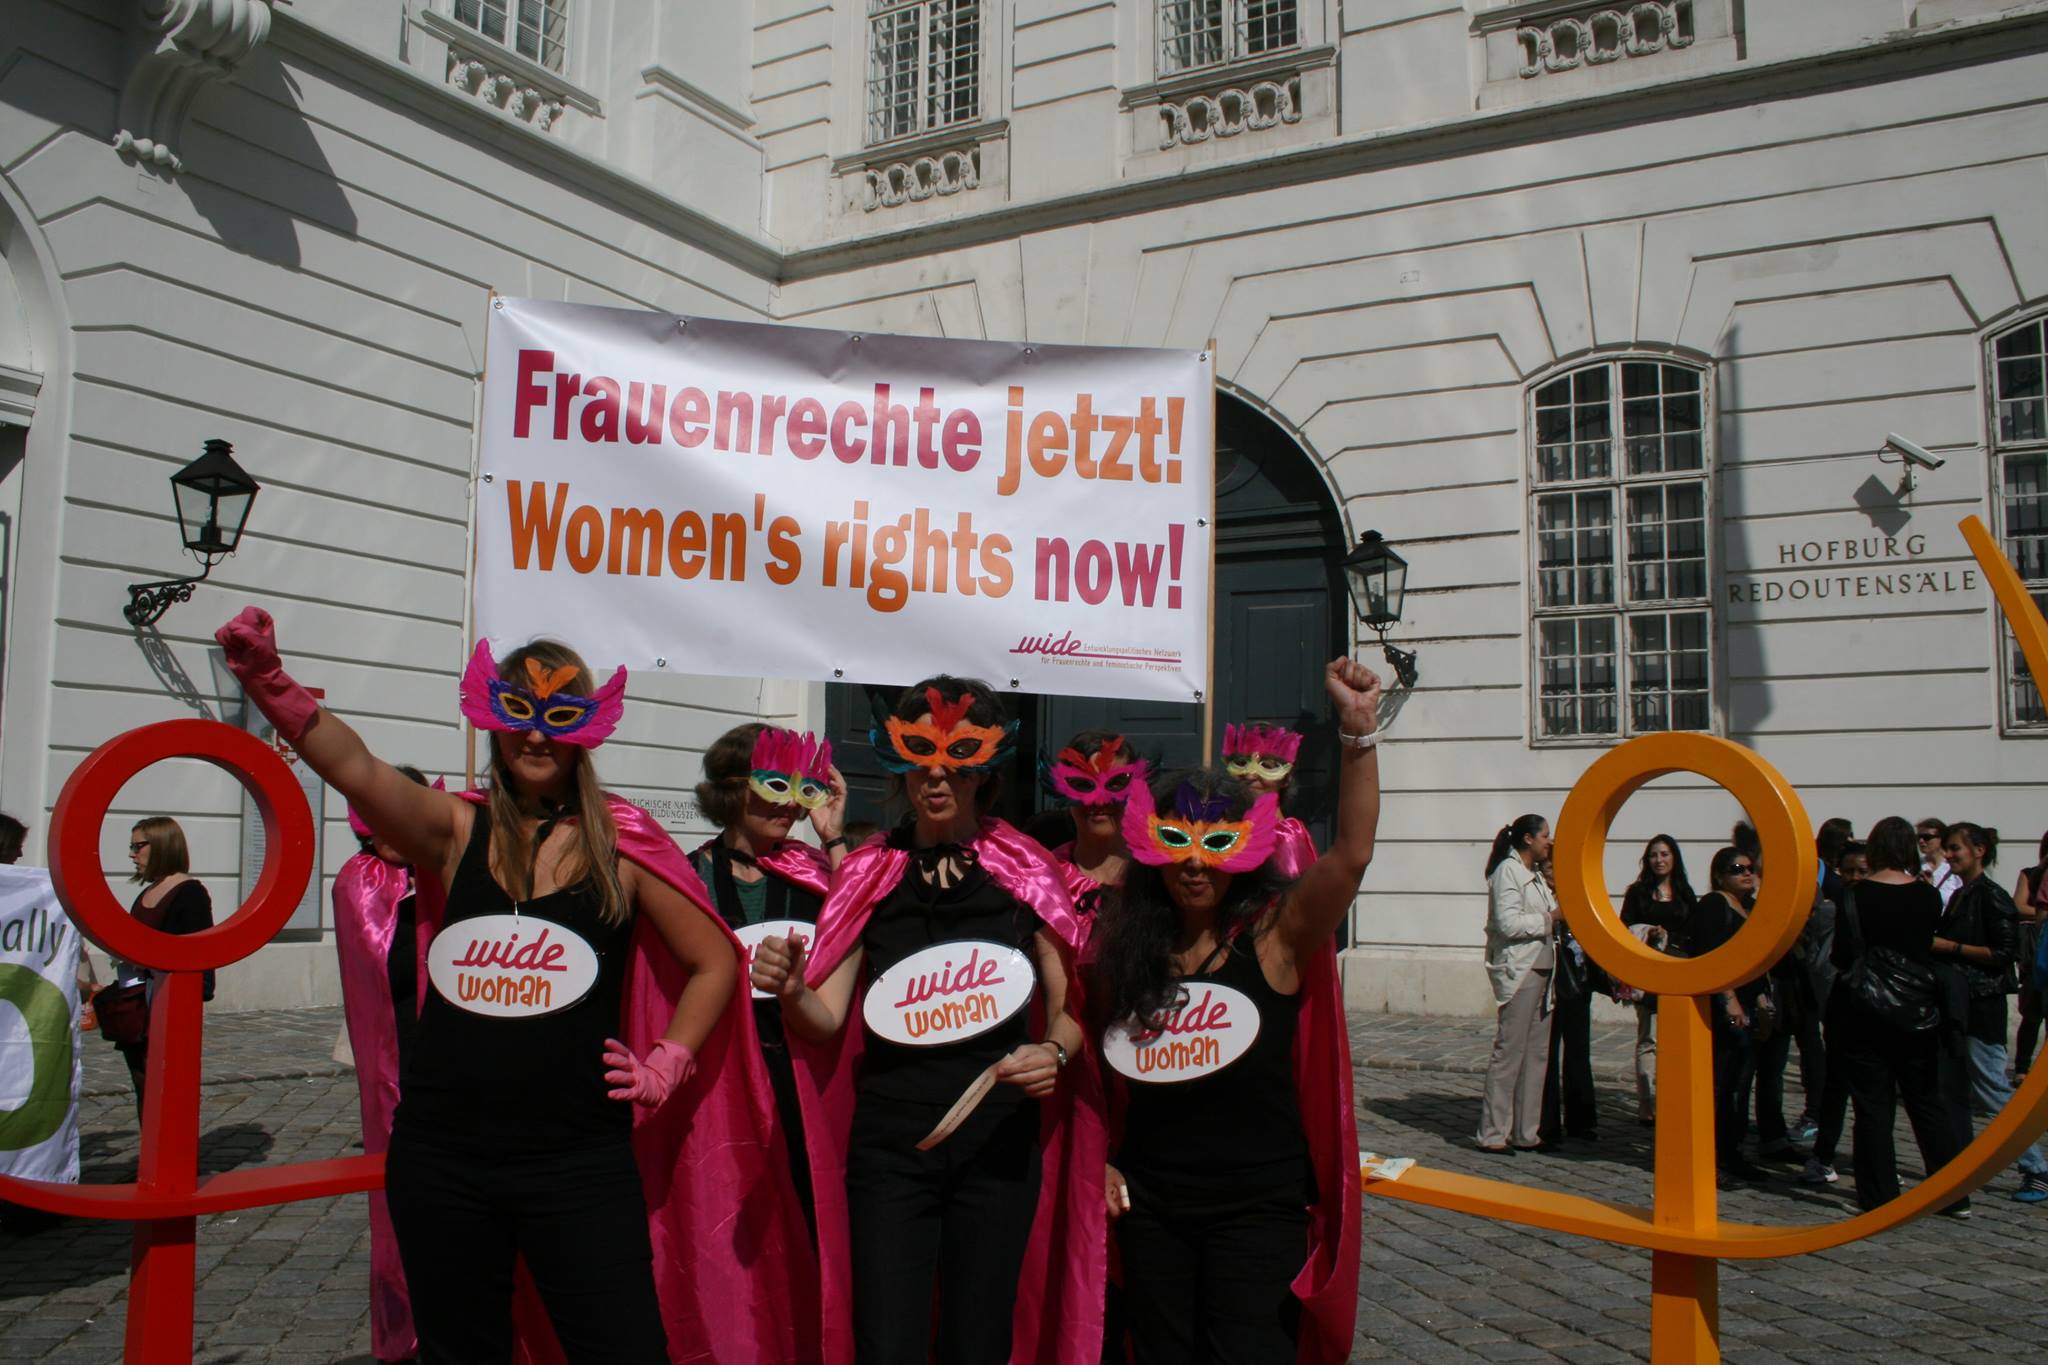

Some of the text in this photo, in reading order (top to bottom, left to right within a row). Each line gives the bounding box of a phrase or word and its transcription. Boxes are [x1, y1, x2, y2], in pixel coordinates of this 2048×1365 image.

[513, 348, 1185, 497] Frauenrechte jetzt!
[506, 479, 1186, 613] Women's rights now!
[1778, 534, 1926, 564] HOFBURG
[1728, 570, 1977, 603] REDOUTENSÄLE
[1009, 630, 1082, 656] wide
[1041, 656, 1051, 665] für
[1052, 657, 1090, 667] Frauenrechte
[1092, 660, 1103, 668] und
[1145, 663, 1182, 673] Perspektiven
[0, 908, 67, 967] ally
[452, 928, 568, 972] wide
[458, 973, 552, 1008] woman
[894, 948, 1006, 1008] wide
[904, 991, 999, 1038] woman
[1135, 1036, 1220, 1074] woman
